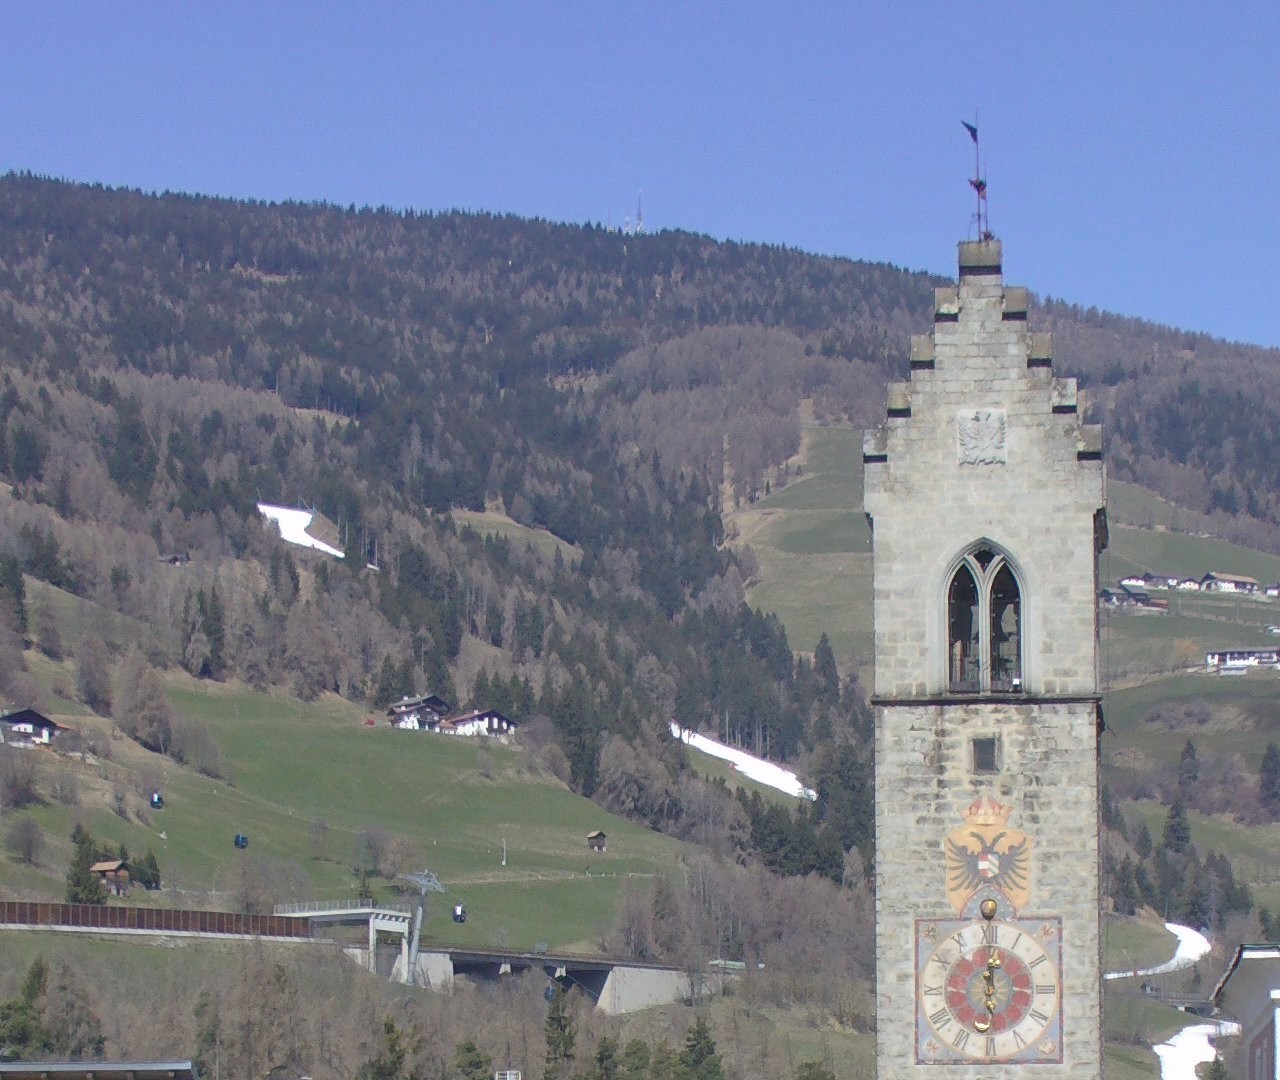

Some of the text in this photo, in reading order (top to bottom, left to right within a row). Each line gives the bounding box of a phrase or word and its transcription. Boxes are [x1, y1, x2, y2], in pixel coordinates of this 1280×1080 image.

[931, 953, 951, 971] X
[1028, 954, 1047, 969] II
[924, 984, 942, 995] IX
[1036, 984, 1055, 995] III
